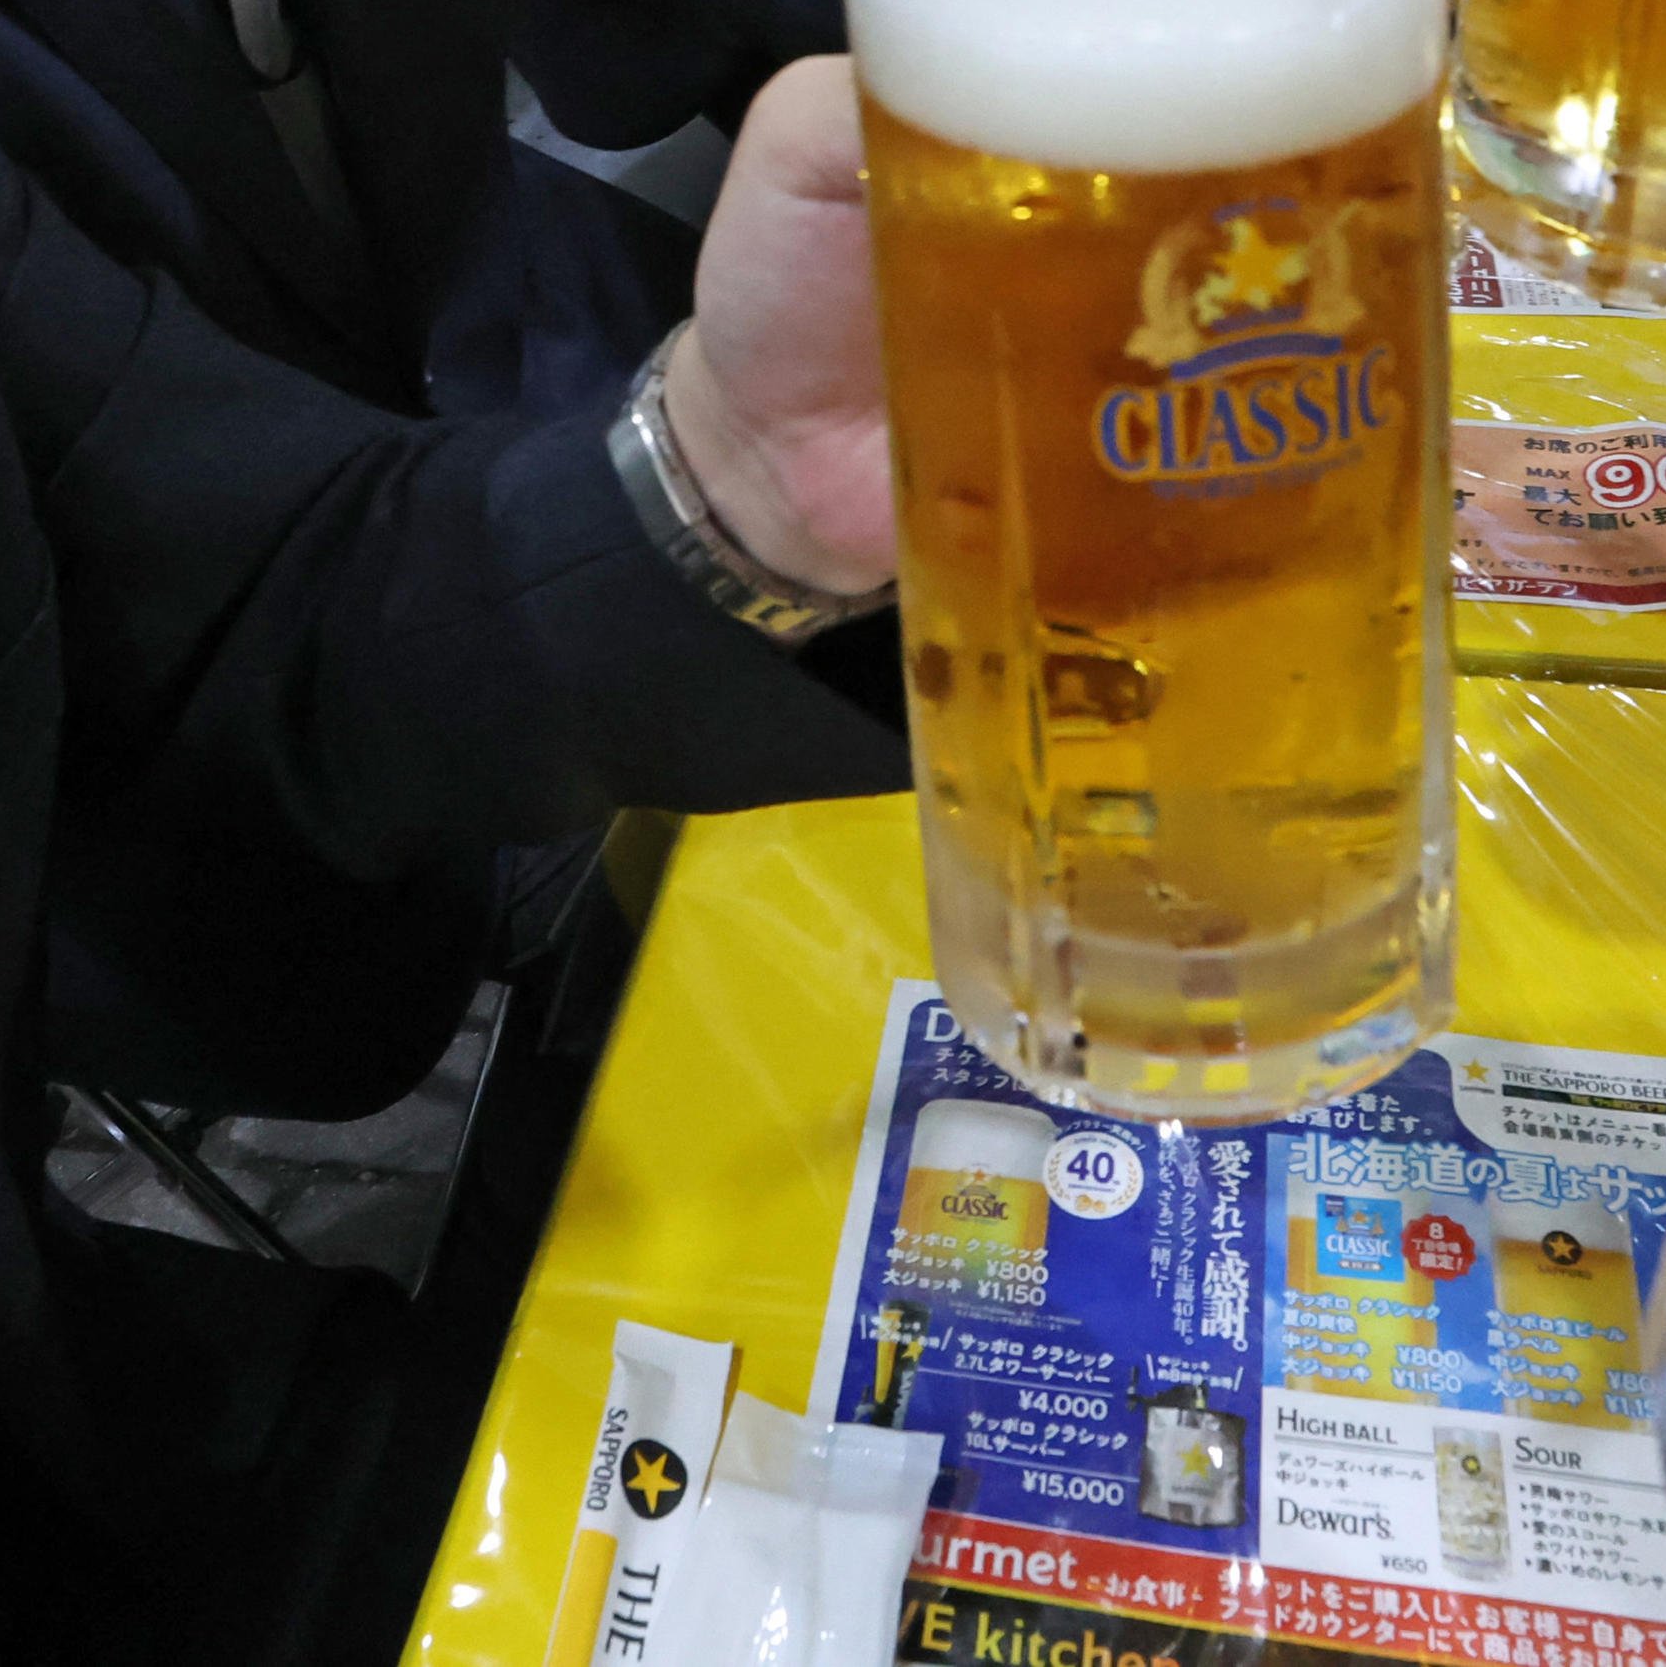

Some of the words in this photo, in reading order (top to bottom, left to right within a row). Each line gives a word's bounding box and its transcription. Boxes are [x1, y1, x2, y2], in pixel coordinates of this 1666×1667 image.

[1099, 346, 1390, 476] CLASSIC
[1525, 466, 1572, 481] MAX
[1523, 485, 1582, 507] 最大
[1502, 1069, 1535, 1084] THE
[1539, 1074, 1626, 1096] SAPPORO
[1067, 1149, 1115, 1184] 40
[941, 1195, 1010, 1221] CLASSIC
[890, 1227, 959, 1249] サッポロ
[965, 1237, 1050, 1263] クラシック
[1200, 1139, 1253, 1353] 愛されて感謝。
[1326, 1233, 1393, 1258] CLASSIC
[886, 1247, 966, 1271] 中ジョッキ
[986, 1258, 1050, 1286] ¥800
[882, 1268, 963, 1294] 大ジョッキ
[1283, 1290, 1350, 1312] サッポロ
[957, 1333, 1024, 1356] サッポロ
[1031, 1343, 1115, 1369] クラシック
[1397, 1345, 1461, 1368] ¥800
[967, 1410, 1035, 1436] サッポロ
[1044, 1423, 1129, 1451] クラシック
[1343, 1422, 1399, 1445] BALL
[585, 1406, 629, 1513] SAPPORO
[1381, 1554, 1428, 1574] ¥650
[604, 1563, 661, 1662] THE
